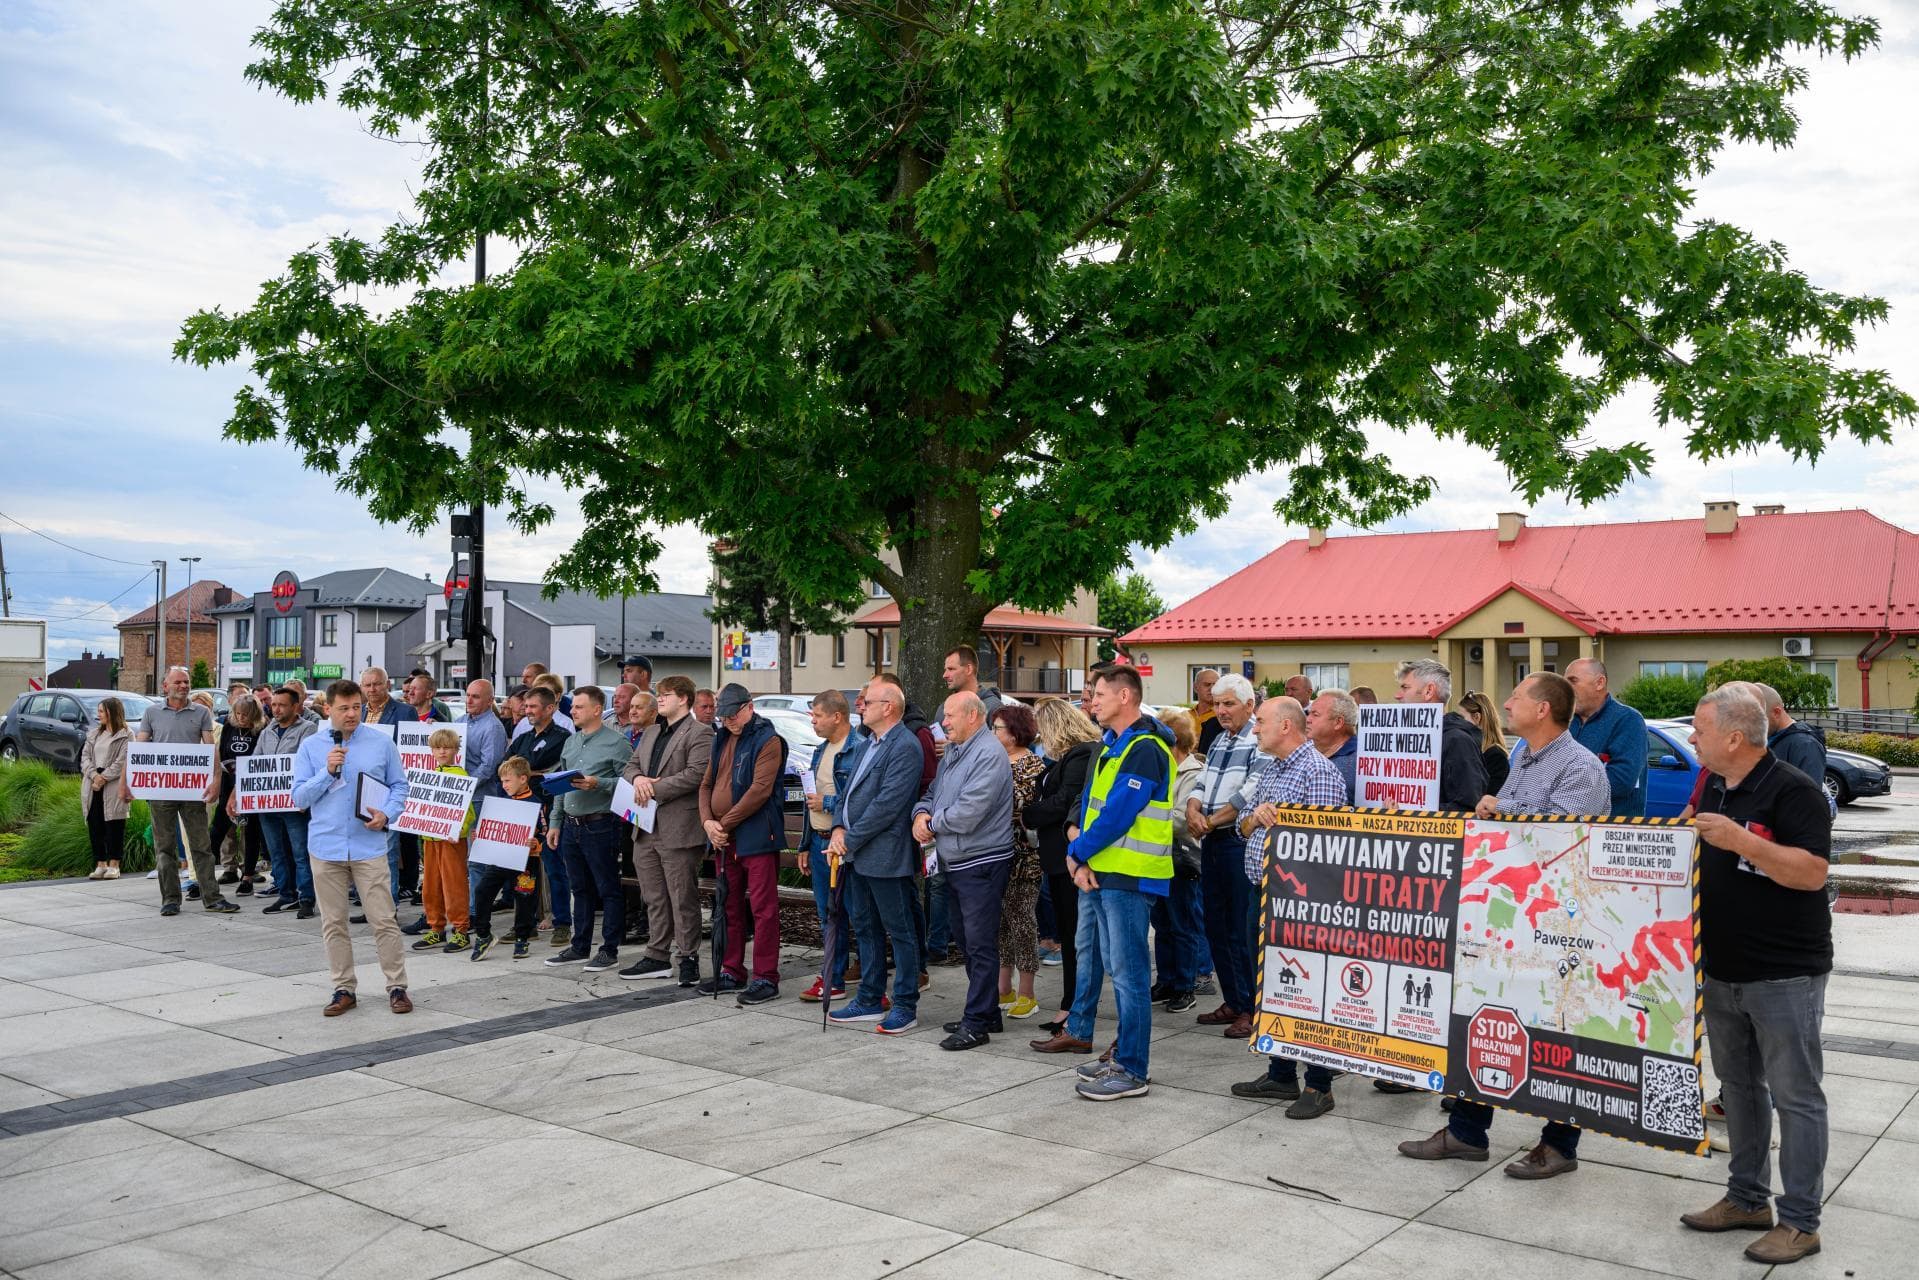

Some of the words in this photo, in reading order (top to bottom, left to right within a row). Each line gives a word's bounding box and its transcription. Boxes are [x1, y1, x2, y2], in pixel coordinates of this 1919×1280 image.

[319, 666, 340, 675] APTEKA
[1361, 708, 1398, 727] WŁADZA
[1401, 708, 1439, 730] MILCZY,
[400, 734, 419, 746] SKORO
[1364, 733, 1393, 752] LUDZIE
[1396, 733, 1431, 757] WIEDZĄ
[131, 753, 155, 765] SKORO
[156, 754, 168, 766] NIE
[170, 754, 209, 766] SŁUCHACIE
[248, 758, 277, 774] GMINA
[280, 757, 291, 772] TO
[1358, 757, 1381, 776] PRZY
[1384, 758, 1437, 780] WYBORACH
[132, 772, 209, 788] ZDECYDUJEMY
[407, 770, 440, 786] WŁADZA
[242, 796, 255, 810] NIE
[433, 790, 464, 808] WIEDZĄ
[1365, 782, 1426, 808] ODPOWIEDZĄ!
[418, 803, 465, 822] WYBORACH
[398, 815, 452, 837] ODPOWIEDZĄ!
[478, 818, 531, 847] REFERENDUM
[1280, 813, 1314, 825] NASZA
[1318, 815, 1352, 827] GMINA
[1363, 818, 1393, 831] NASZA
[1397, 820, 1457, 834] PRZYSZŁOŚĆ
[1605, 831, 1635, 841] OBSZARY
[1637, 832, 1674, 843] WSKAZANE
[1276, 830, 1410, 871] OBAWIAMY
[1418, 842, 1454, 879] SIĘ
[1603, 843, 1623, 853] PRZEZ
[1626, 844, 1676, 856] MINISTERSTWO
[1608, 856, 1625, 865] JAKO
[1628, 857, 1655, 868] IDEALNE
[1658, 858, 1671, 868] POD
[1592, 867, 1632, 878] PRZEMYSŁOWE
[1635, 870, 1665, 880] MAGAZYNY
[1343, 870, 1447, 912] UTRATY
[1272, 897, 1360, 928] WARTOŚCI
[1367, 908, 1450, 939] GRUNTÓW
[1270, 920, 1276, 944] I
[1283, 921, 1446, 968] NIERUCHOMOŚCI
[1534, 929, 1595, 950] Pawęzów
[1284, 986, 1302, 994] UTRATY
[1295, 1022, 1335, 1036] OBAWIAMY
[1337, 1030, 1350, 1040] SIĘ
[1351, 1032, 1380, 1045] UTRATY
[1476, 1017, 1518, 1041] STOP
[1294, 1031, 1330, 1045] WARTOŚCI
[1332, 1039, 1367, 1053] GRUNTÓW
[1374, 1047, 1435, 1068] NIERUCHOMOŚCI!
[1472, 1037, 1521, 1056] MAGAZYNOM
[1281, 1045, 1300, 1056] STOP
[1301, 1050, 1342, 1066] Magazynom
[1343, 1058, 1367, 1072] Energii
[1377, 1066, 1415, 1082] Pawęzowie
[1480, 1052, 1511, 1067] ENERGII
[1532, 1041, 1572, 1068] STOP
[1576, 1053, 1638, 1084] MAGAZYNOM
[1530, 1078, 1572, 1104] CHROŃMY
[1575, 1090, 1601, 1116] NASZĄ
[1604, 1094, 1638, 1124] GMINĘ!
